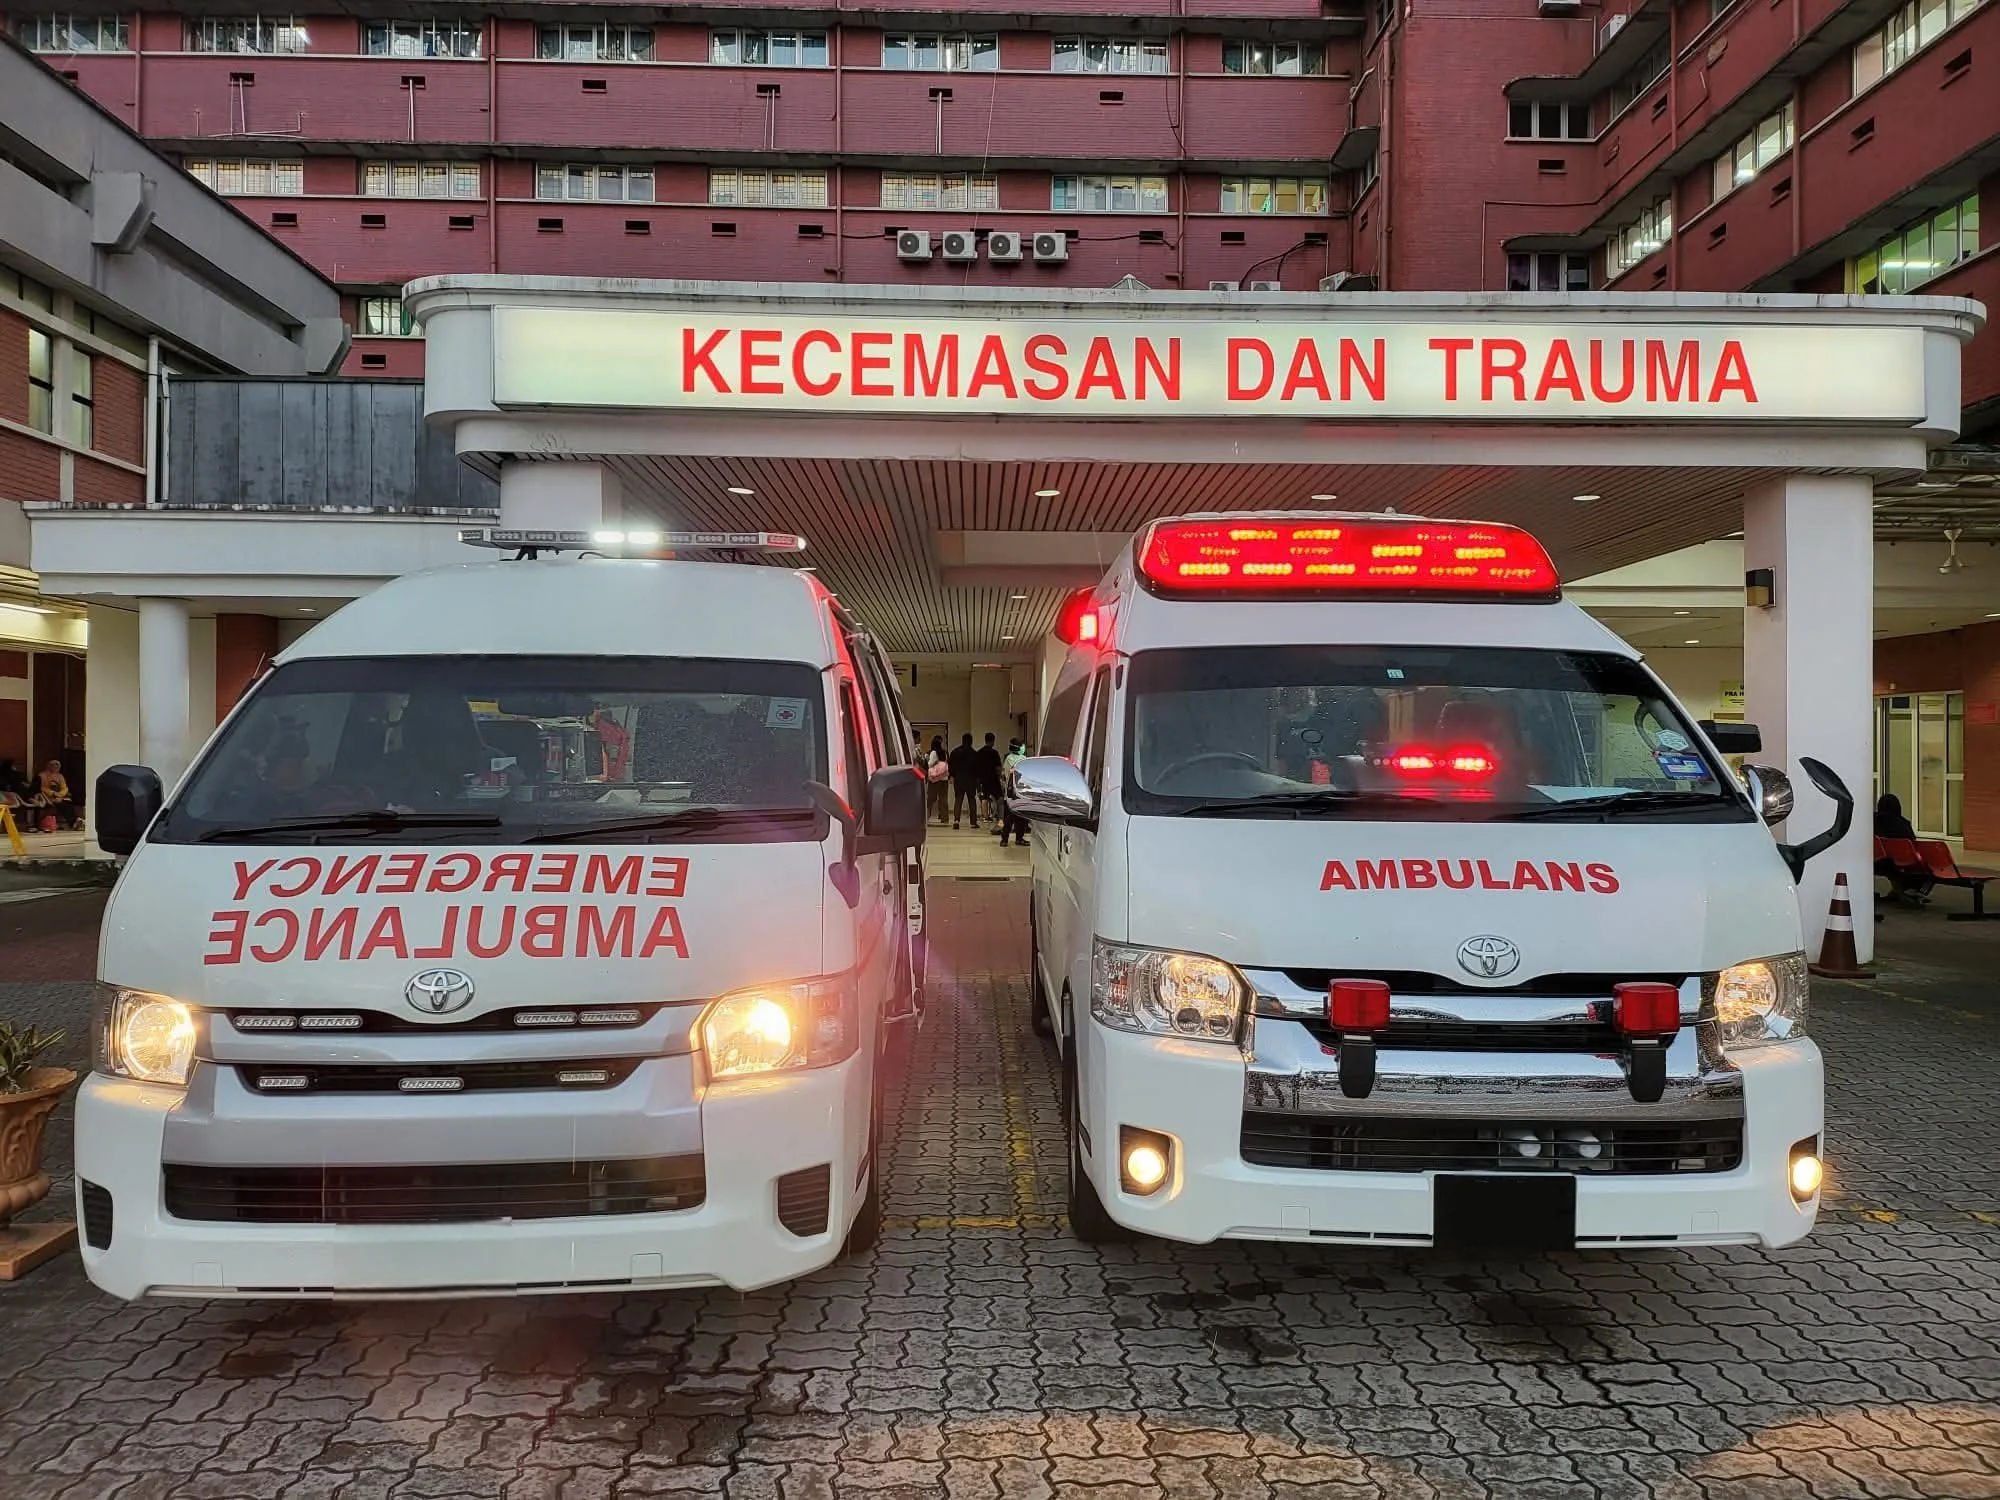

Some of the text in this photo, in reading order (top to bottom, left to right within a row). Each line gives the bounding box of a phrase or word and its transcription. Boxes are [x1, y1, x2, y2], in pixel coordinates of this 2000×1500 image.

[682, 327, 1759, 404] KECEMASAN DAN TRAUMA
[1319, 858, 1620, 894] AMBULANS
